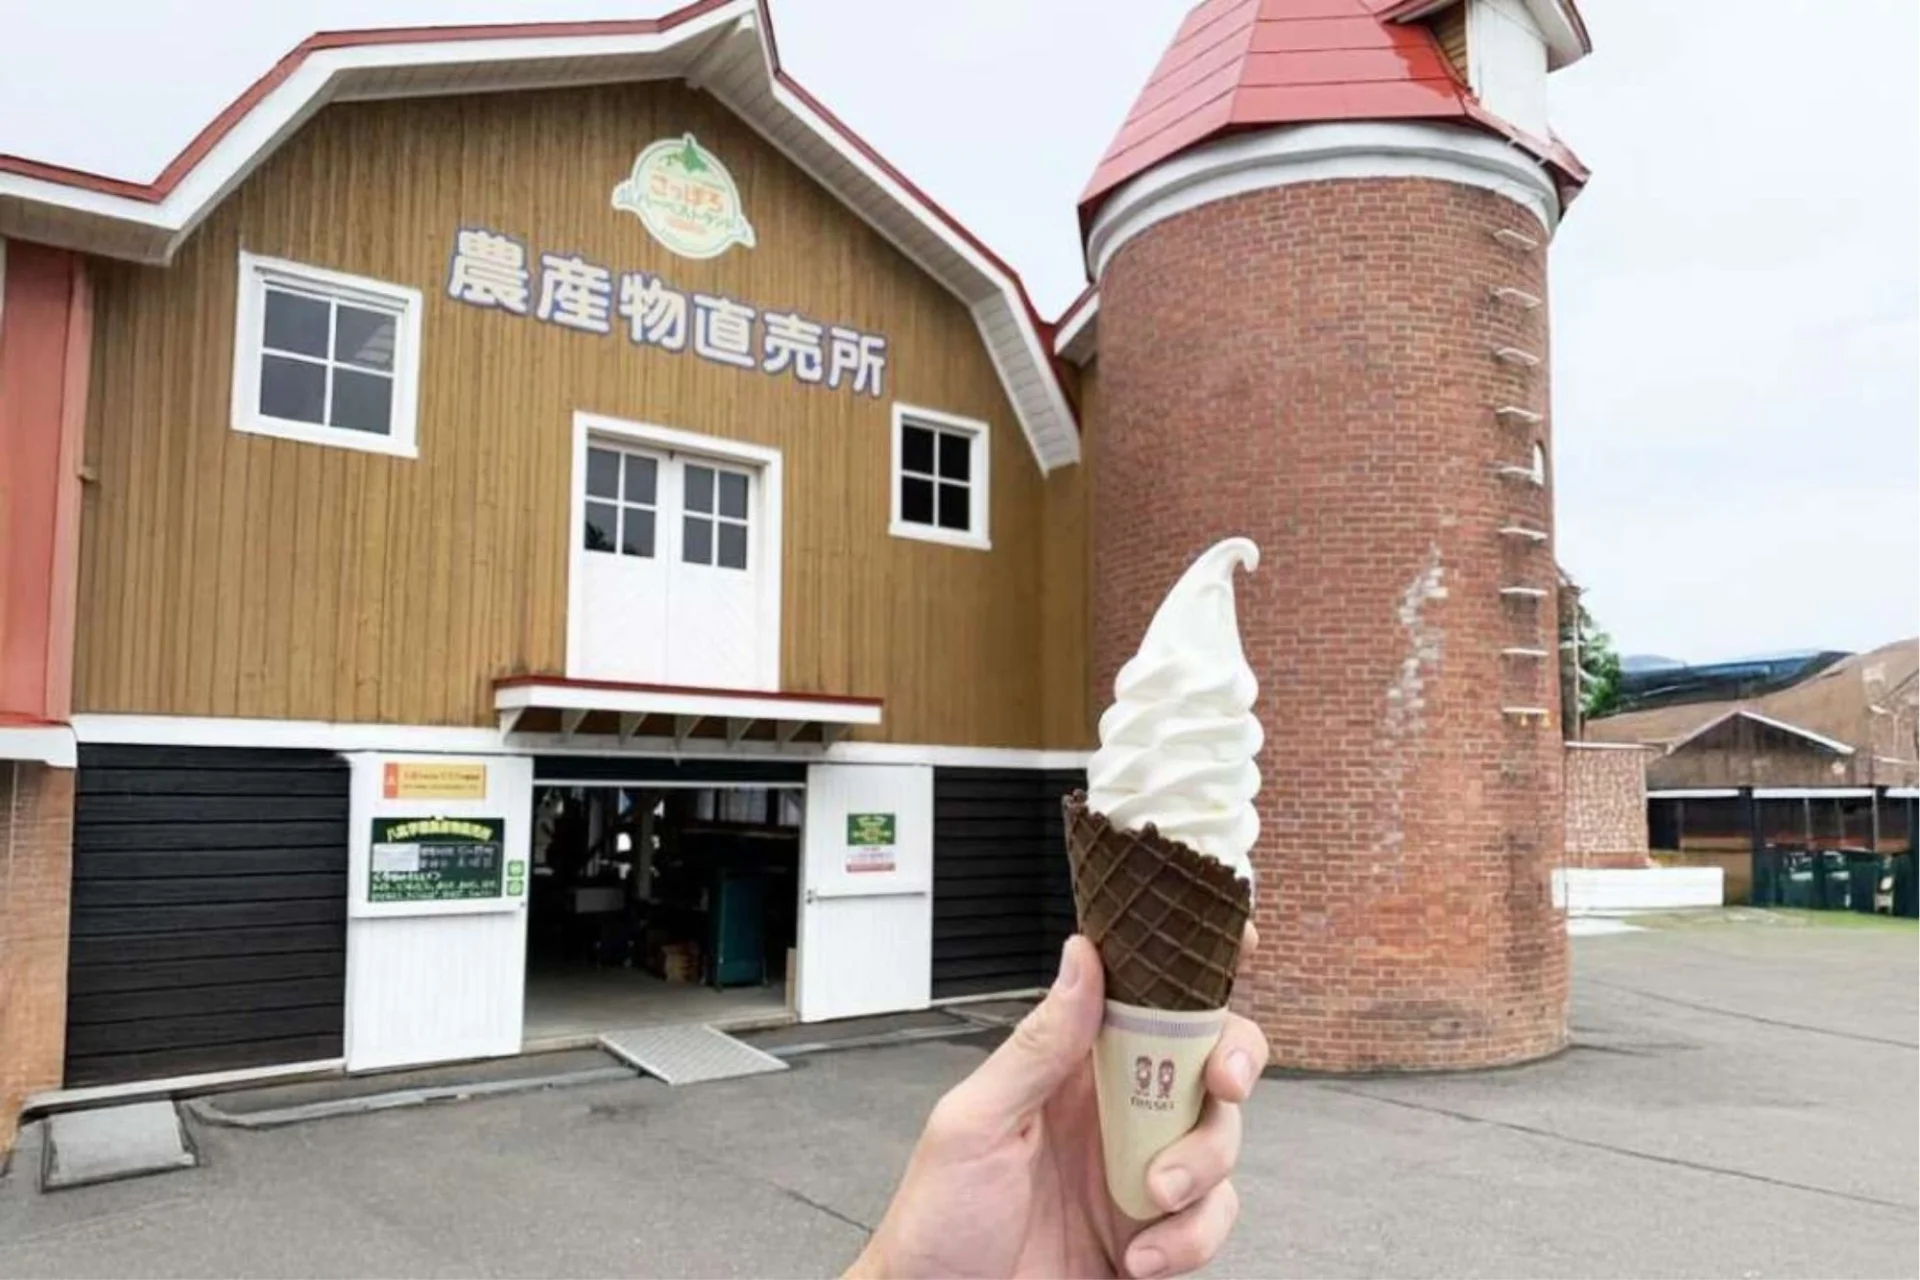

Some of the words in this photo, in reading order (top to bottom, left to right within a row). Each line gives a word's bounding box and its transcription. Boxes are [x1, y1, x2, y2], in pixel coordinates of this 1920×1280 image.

[447, 227, 887, 397] 農産物直売所
